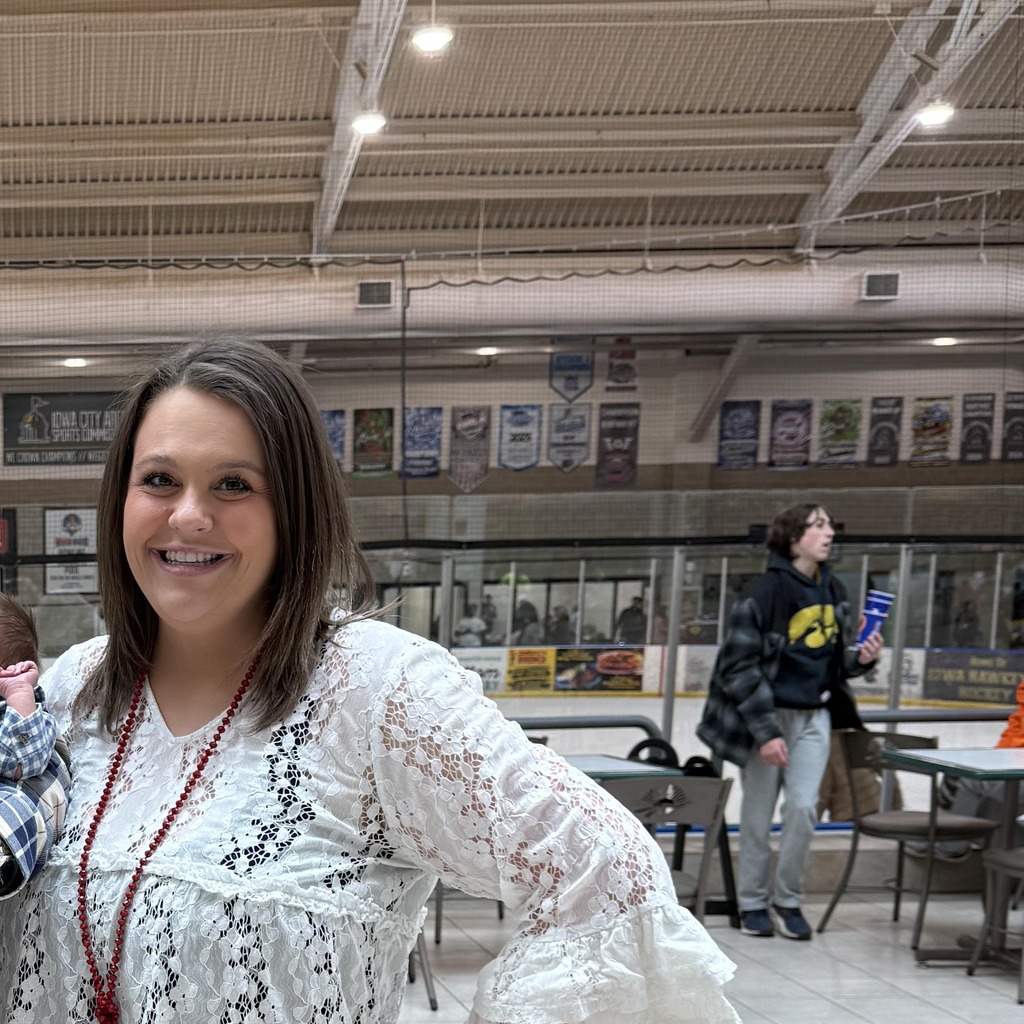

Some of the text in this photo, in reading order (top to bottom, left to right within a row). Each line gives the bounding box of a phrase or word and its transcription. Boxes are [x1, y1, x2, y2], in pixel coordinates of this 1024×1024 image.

[51, 410, 77, 429] IOWA
[79, 410, 102, 429] CITY
[52, 429, 80, 442] SPORTS
